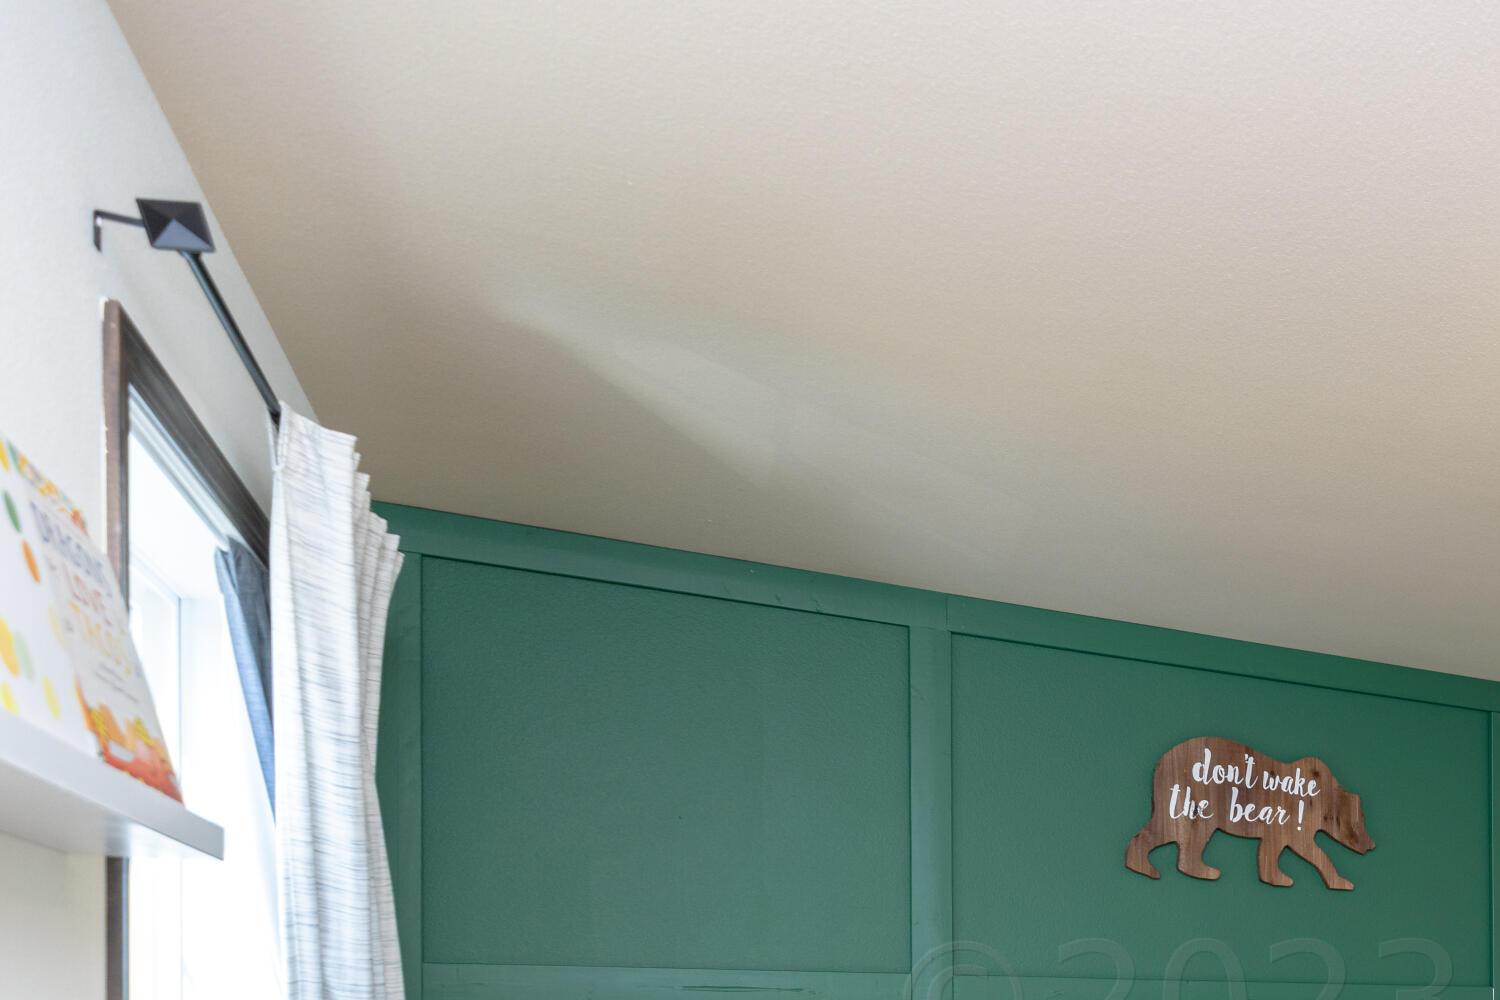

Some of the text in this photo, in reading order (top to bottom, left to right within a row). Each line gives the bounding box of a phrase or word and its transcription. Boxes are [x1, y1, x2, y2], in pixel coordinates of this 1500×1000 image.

[1192, 748, 1321, 798] don't wake
[1168, 783, 1214, 820] the
